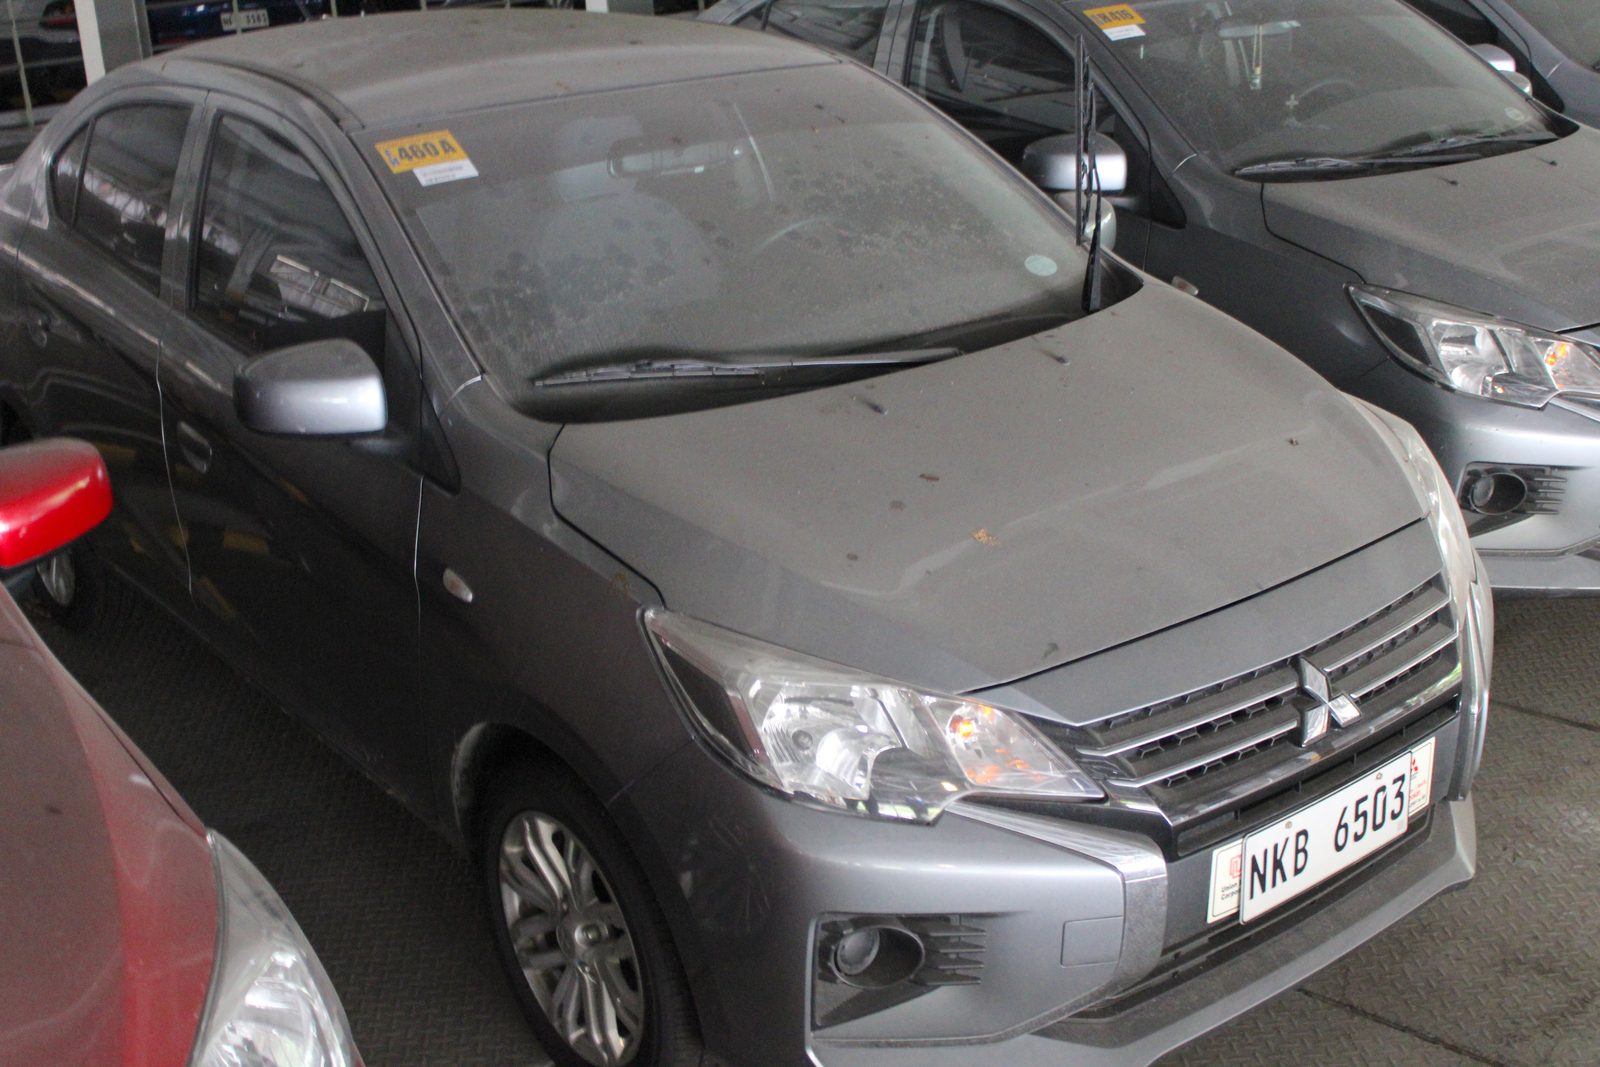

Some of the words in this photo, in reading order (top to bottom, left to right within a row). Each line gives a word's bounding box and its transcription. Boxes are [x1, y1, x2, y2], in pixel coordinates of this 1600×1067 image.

[398, 141, 440, 161] 460
[1249, 828, 1309, 900] NKB
[1333, 773, 1406, 853] 6503
